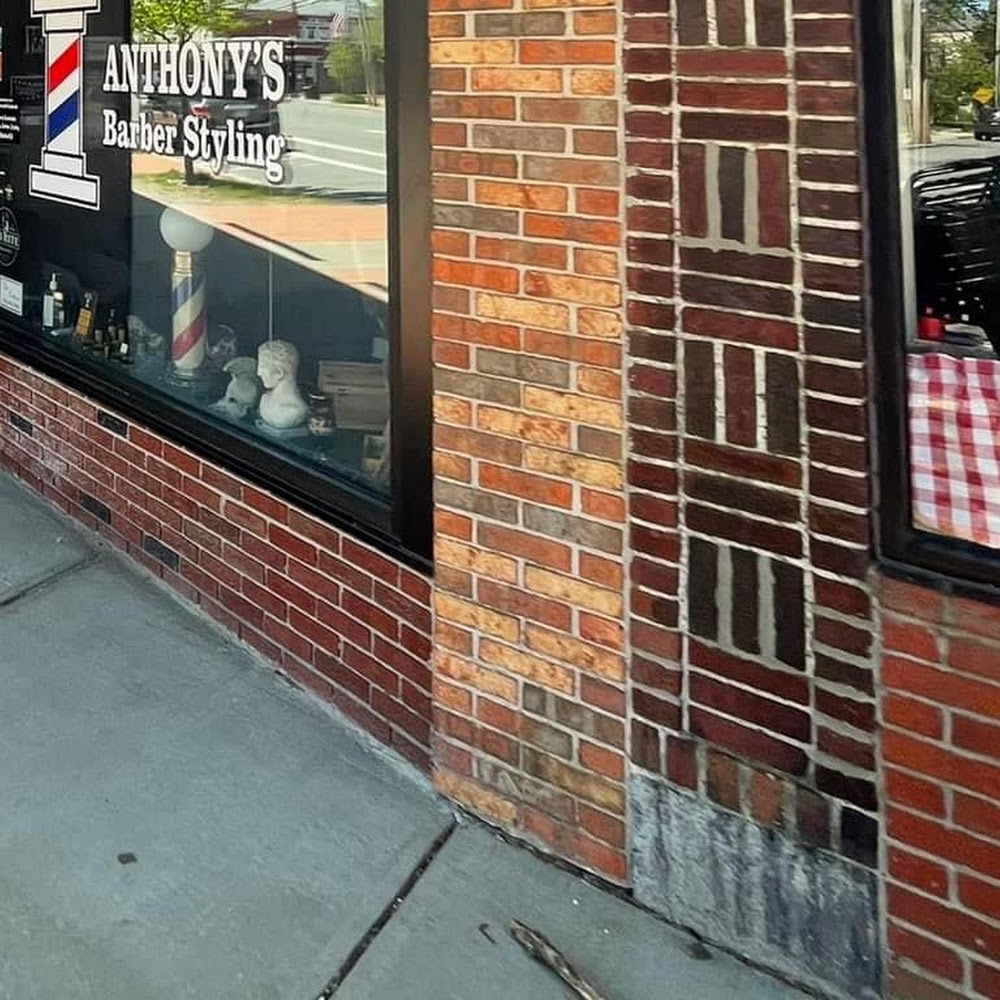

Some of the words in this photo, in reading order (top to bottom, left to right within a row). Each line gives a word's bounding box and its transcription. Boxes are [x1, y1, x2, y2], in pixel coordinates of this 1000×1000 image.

[102, 40, 287, 102] ANTHONY'S
[102, 109, 178, 153] Barber
[183, 114, 286, 184] Styling
